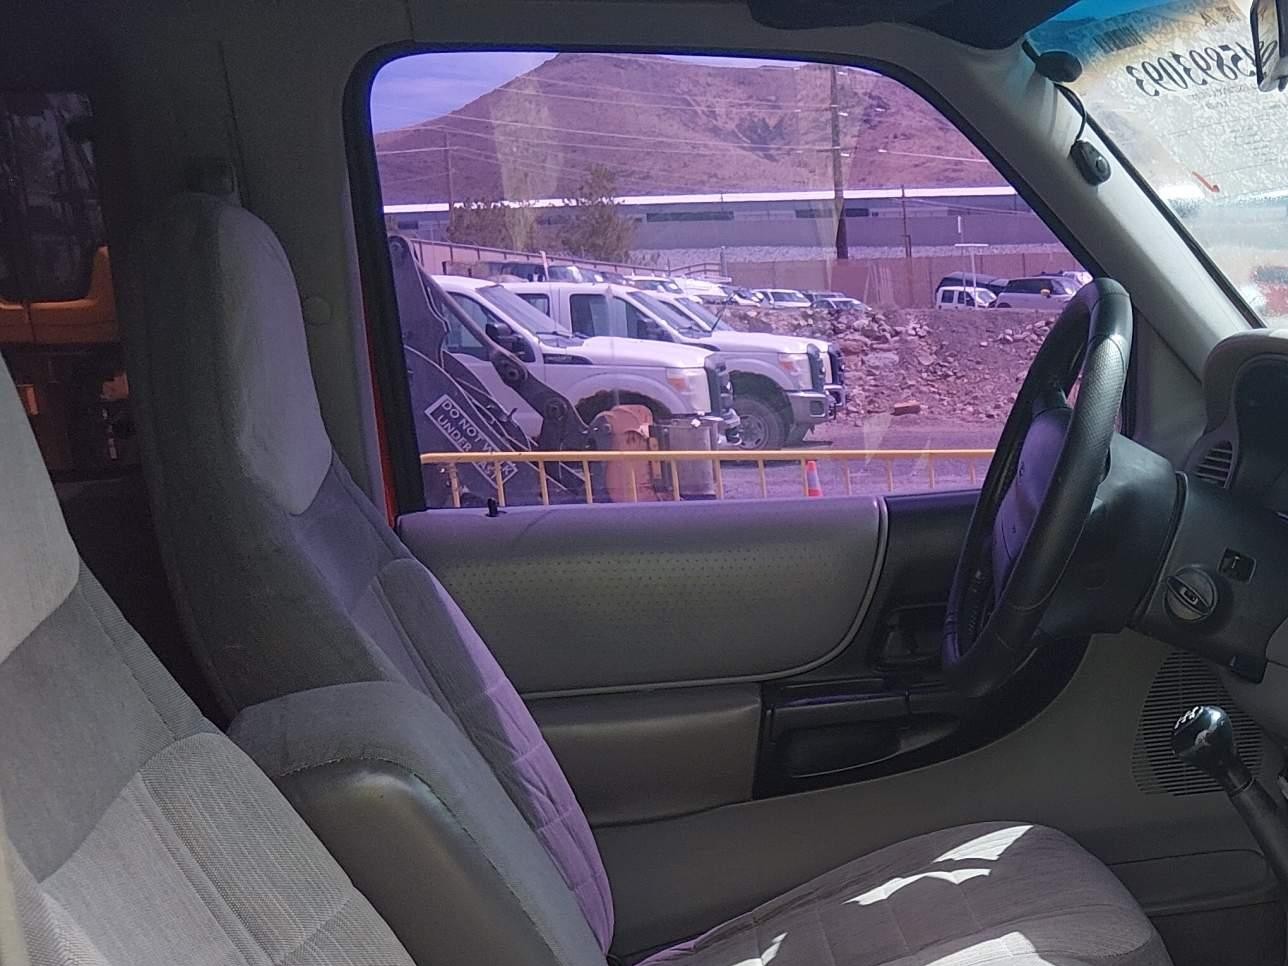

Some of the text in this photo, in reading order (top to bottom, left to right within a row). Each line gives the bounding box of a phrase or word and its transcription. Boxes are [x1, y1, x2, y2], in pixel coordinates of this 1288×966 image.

[437, 415, 472, 452] UNDER
[441, 400, 460, 419] DO
[458, 418, 483, 442] NOT
